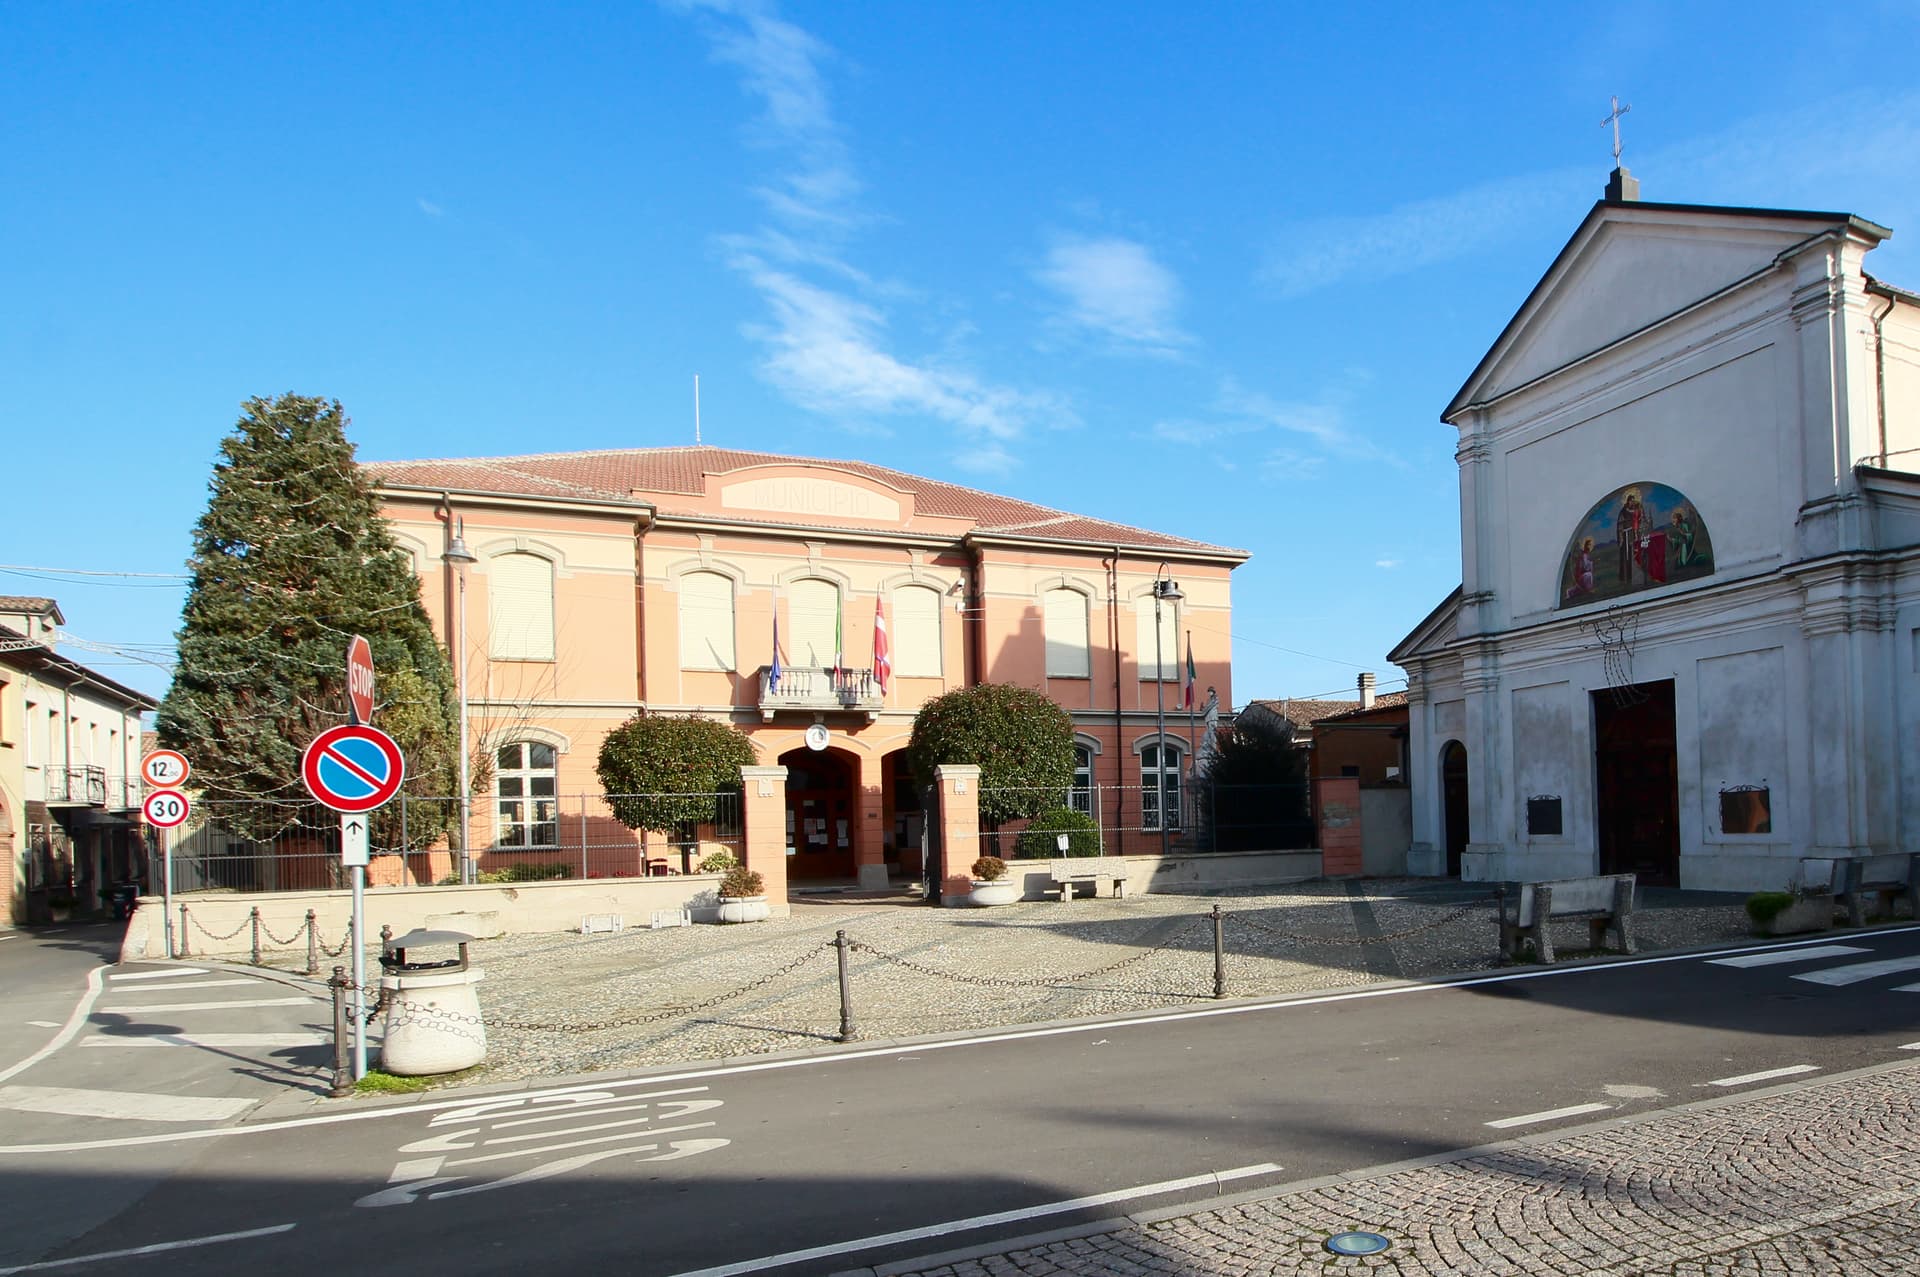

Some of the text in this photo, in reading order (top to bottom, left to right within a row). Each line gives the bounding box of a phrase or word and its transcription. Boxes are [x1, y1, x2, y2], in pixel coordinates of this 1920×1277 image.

[754, 480, 870, 514] MUNICIPIO
[352, 662, 373, 698] STOP
[154, 801, 179, 817] 30
